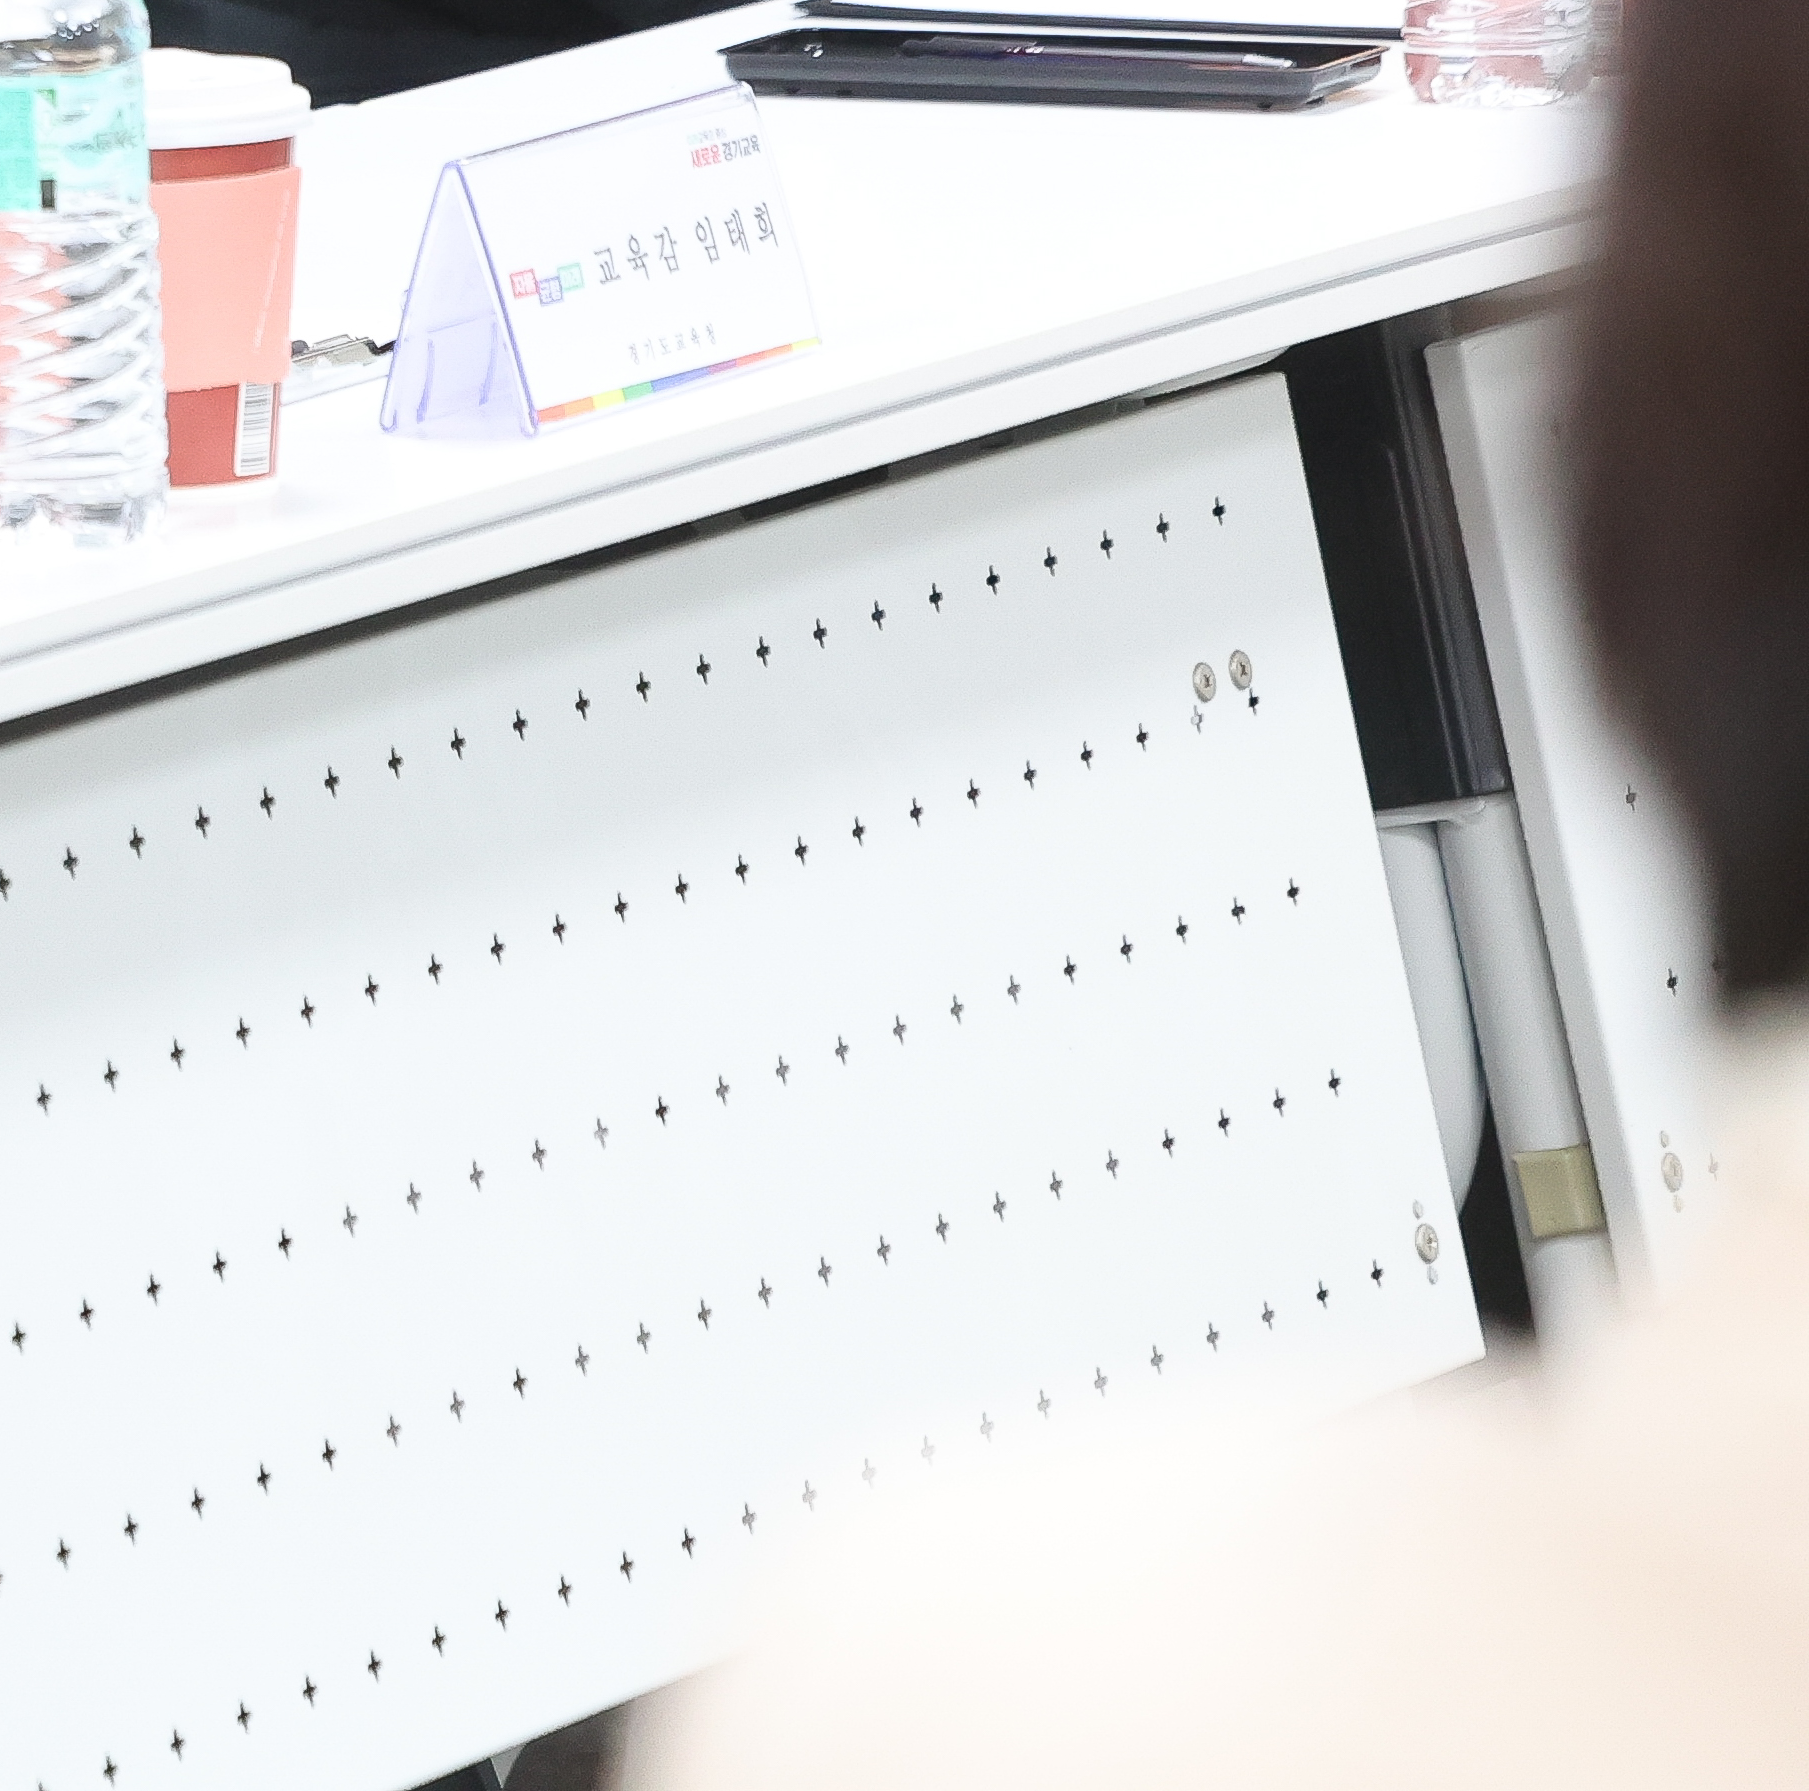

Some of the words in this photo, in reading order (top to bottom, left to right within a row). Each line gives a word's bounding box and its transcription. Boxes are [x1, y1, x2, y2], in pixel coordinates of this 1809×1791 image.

[721, 134, 761, 162] 경기교육
[593, 225, 682, 285] 교육감
[694, 200, 780, 265] 임태희
